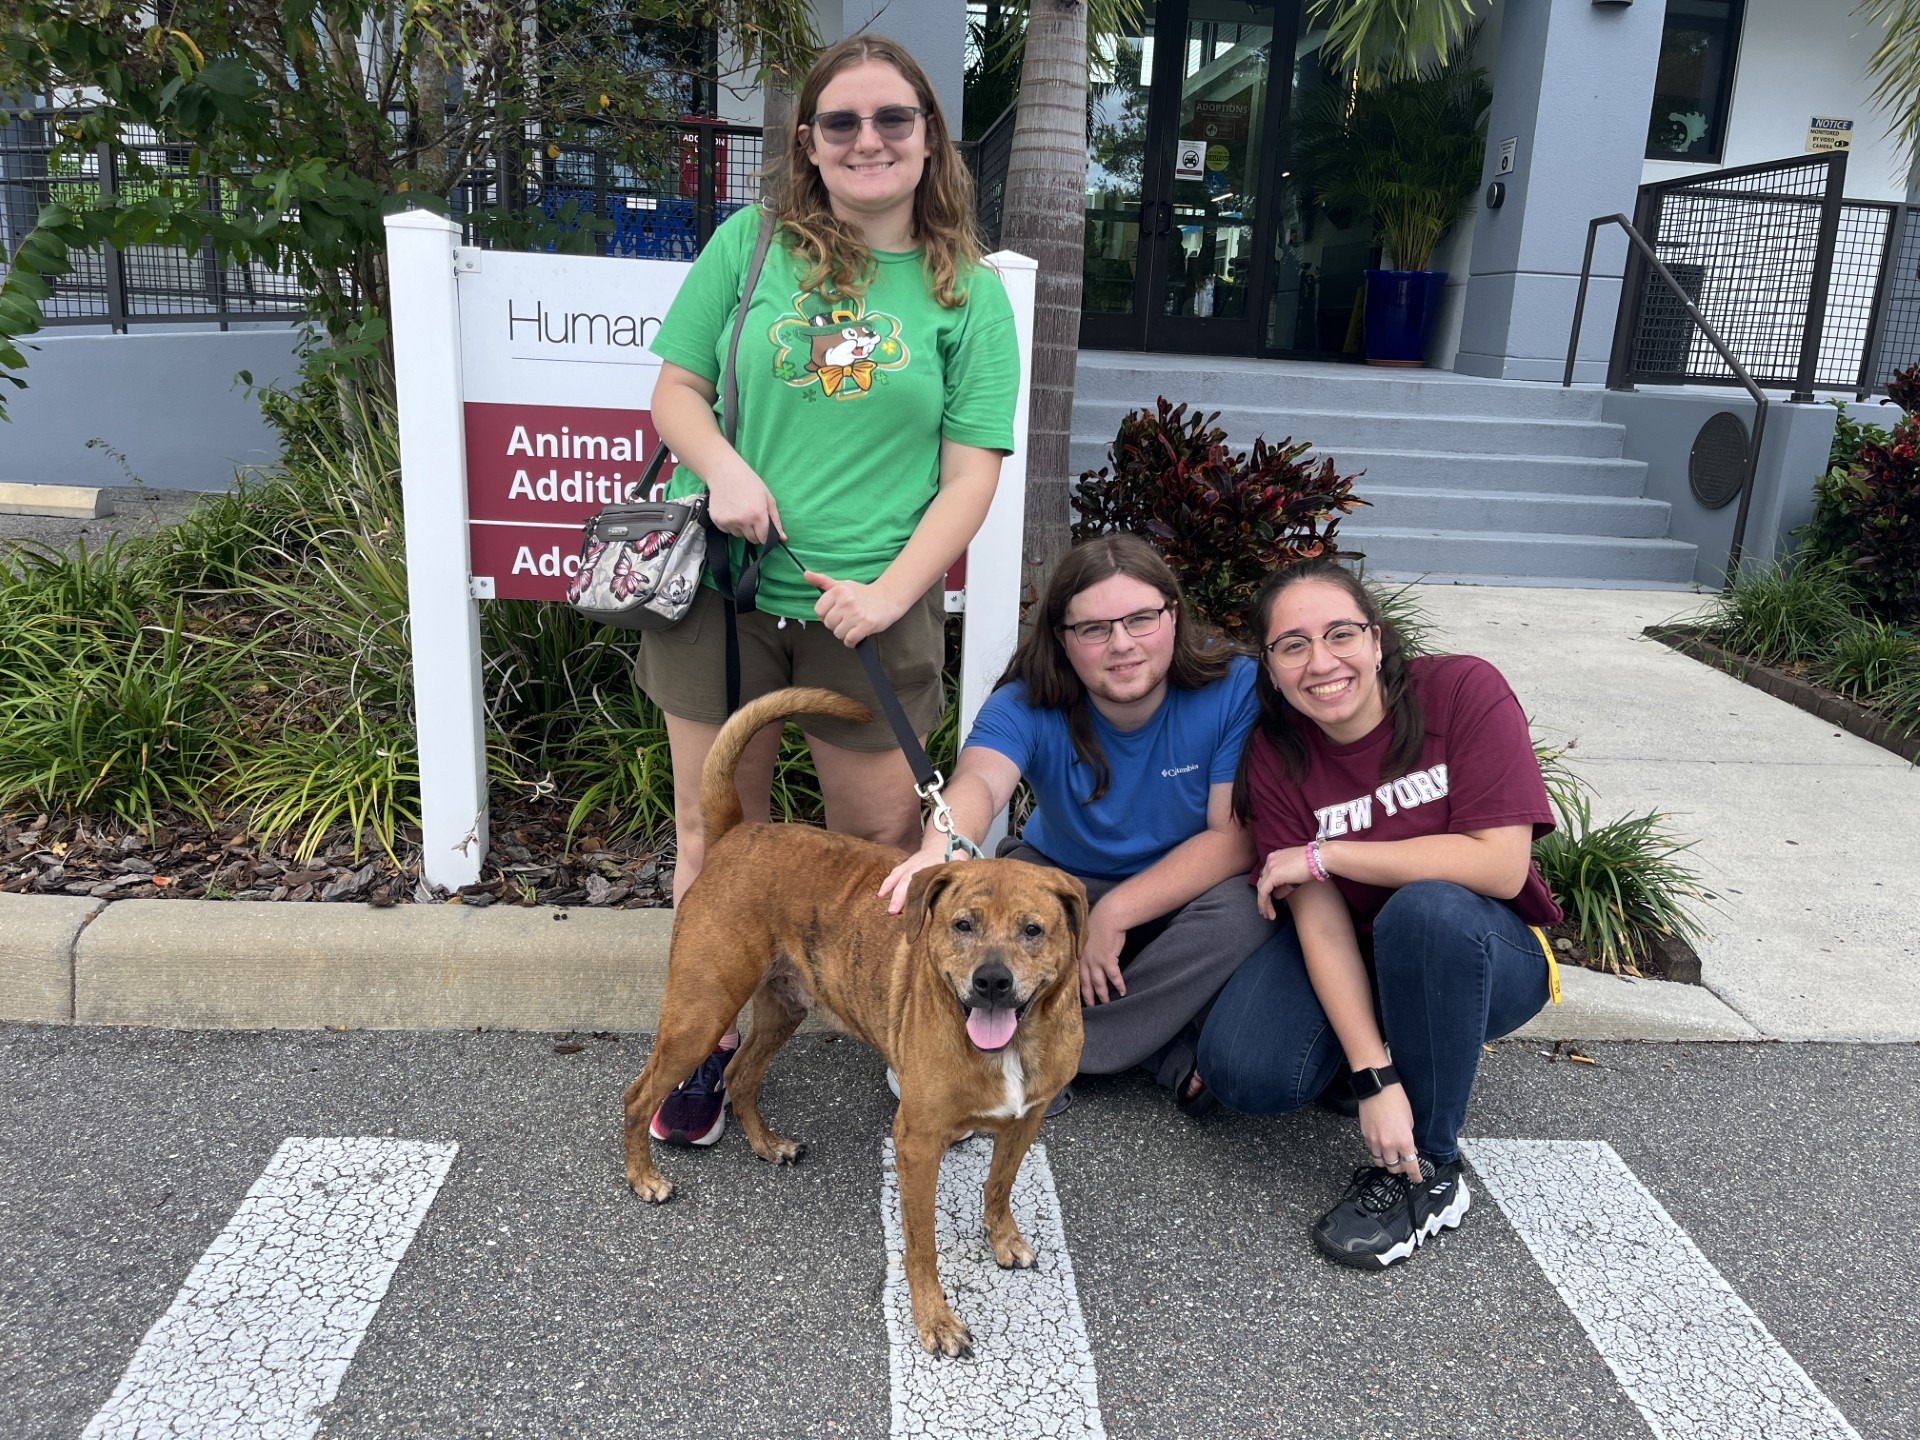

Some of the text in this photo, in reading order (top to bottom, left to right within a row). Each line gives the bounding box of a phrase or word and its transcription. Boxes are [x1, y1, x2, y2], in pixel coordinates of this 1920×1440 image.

[1196, 103, 1248, 113] ADOPTIONS
[1816, 120, 1848, 129] NOTICE
[506, 425, 644, 462] Animal
